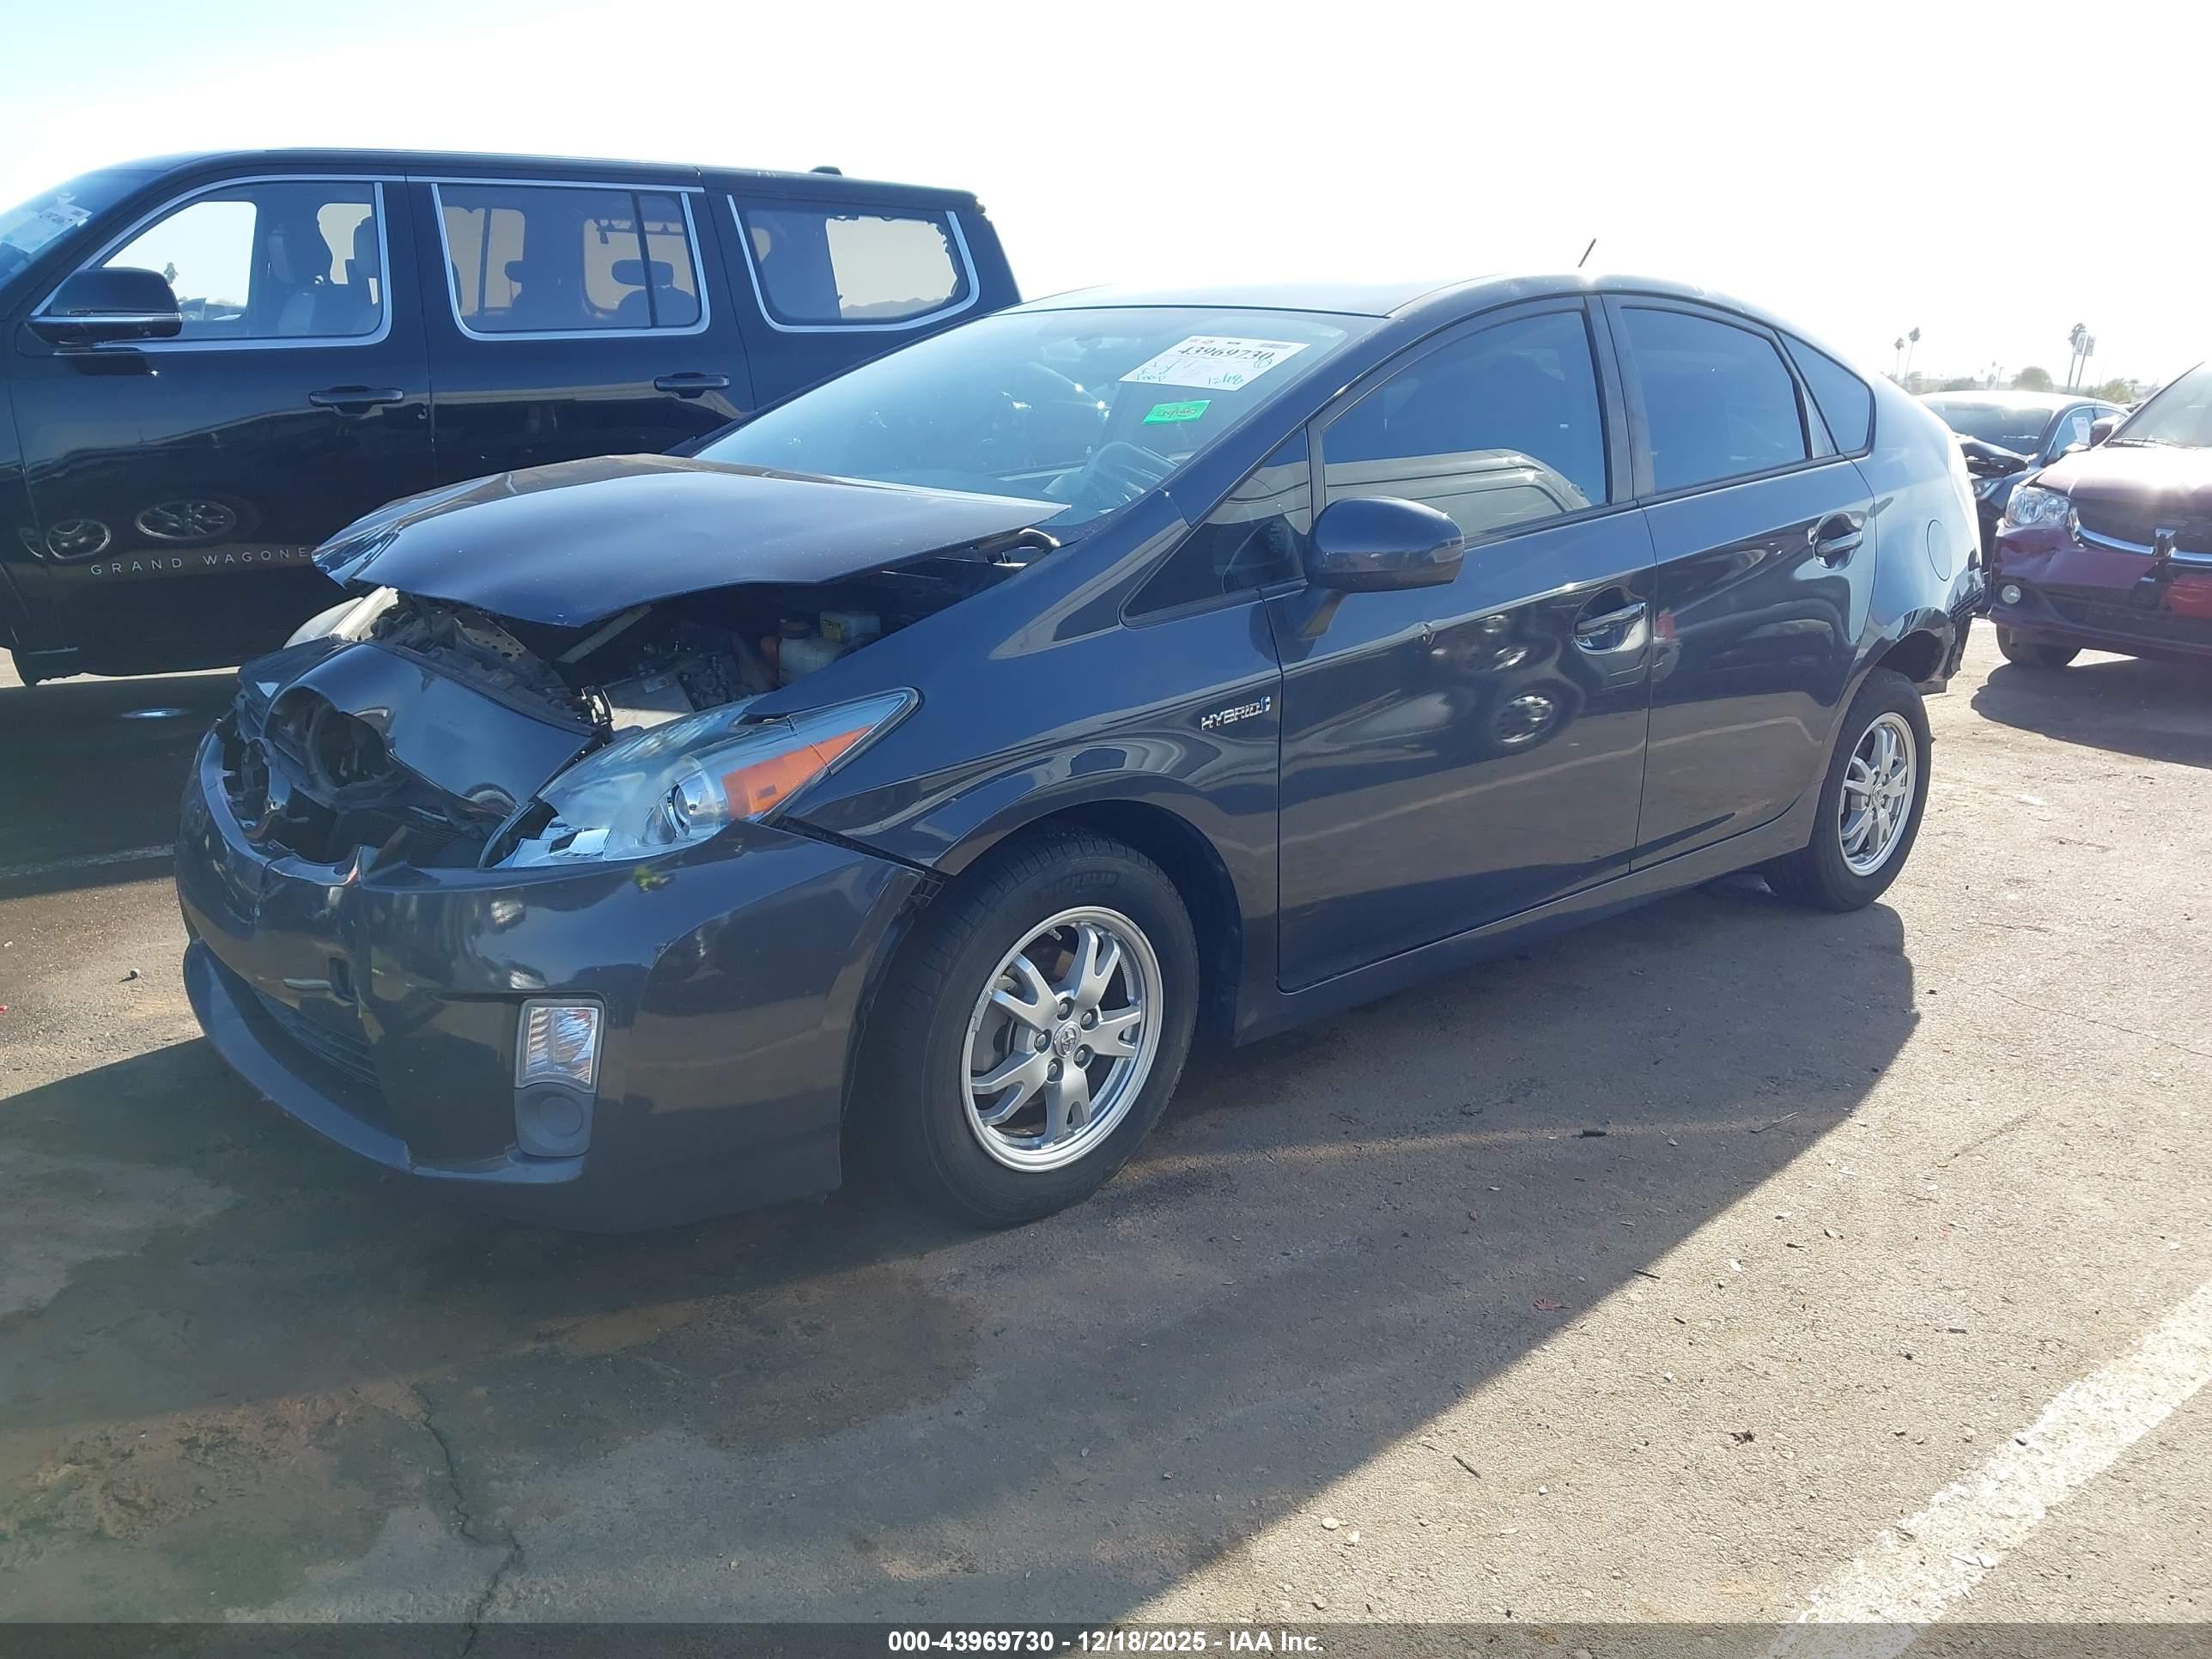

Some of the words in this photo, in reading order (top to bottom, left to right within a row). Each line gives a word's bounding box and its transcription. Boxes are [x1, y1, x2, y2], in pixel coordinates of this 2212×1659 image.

[90, 557, 182, 575] GRAND
[203, 547, 307, 566] WAGONE
[1201, 702, 1261, 731] HYBRID
